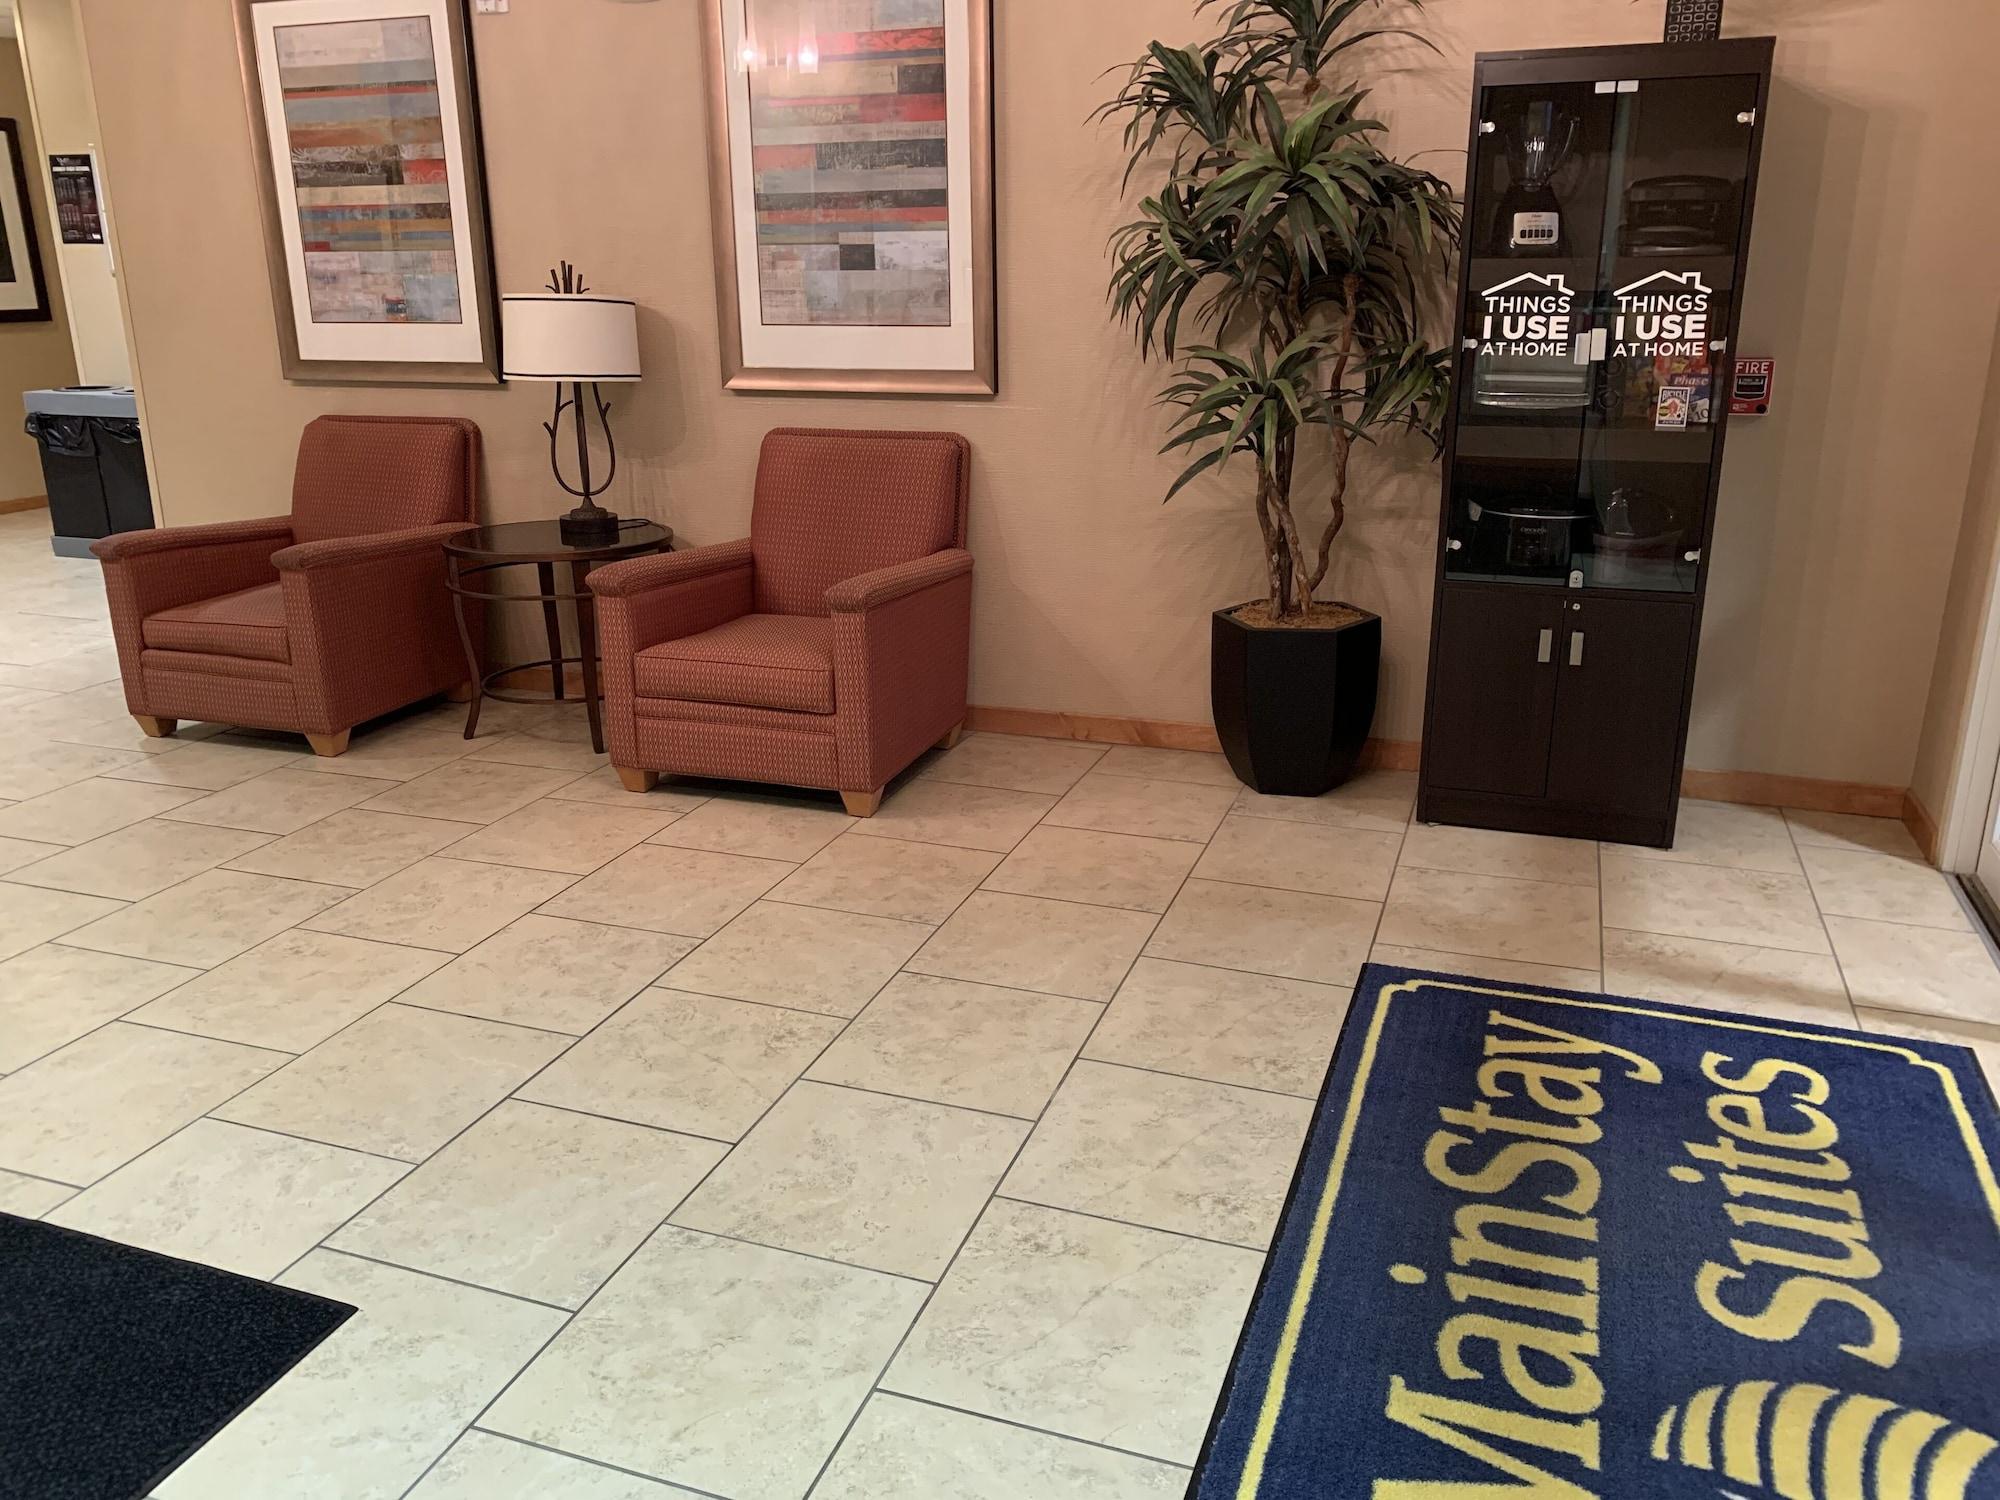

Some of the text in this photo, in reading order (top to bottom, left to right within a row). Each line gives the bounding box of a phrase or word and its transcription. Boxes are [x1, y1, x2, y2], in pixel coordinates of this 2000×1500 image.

[1484, 296, 1571, 314] THINGS
[1616, 294, 1708, 314] THINGS
[1482, 315, 1571, 340] I USE
[1615, 314, 1708, 341] I USE
[1480, 342, 1568, 357] AT HOME
[1612, 341, 1705, 357] AT HOME
[1735, 361, 1770, 374] FIRE
[1674, 374, 1709, 386] Phase
[1661, 390, 1687, 403] BICYCLE
[1669, 1050, 1902, 1369] Suites
[1371, 1009, 1663, 1500] MainStay
